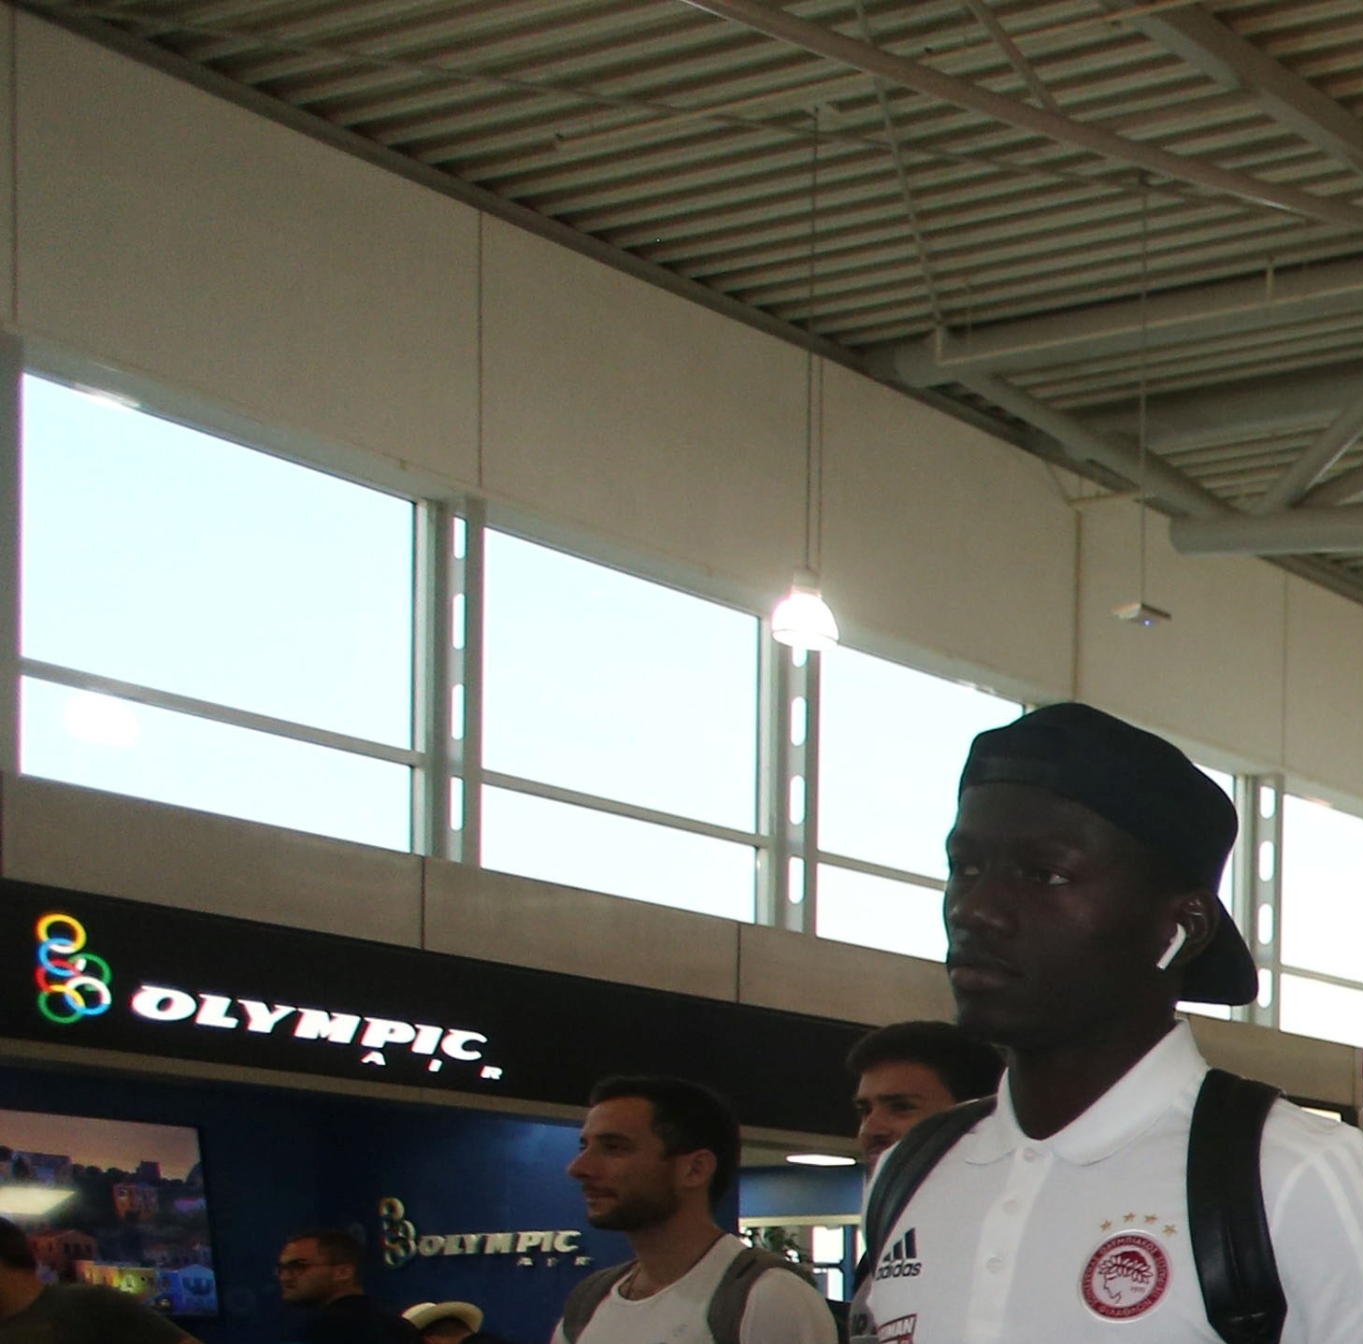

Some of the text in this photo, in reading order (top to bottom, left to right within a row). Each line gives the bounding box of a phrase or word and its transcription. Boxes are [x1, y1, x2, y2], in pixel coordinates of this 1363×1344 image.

[132, 985, 489, 1061] OLYMPIC
[418, 1230, 582, 1257] OLYMPIC
[876, 1259, 922, 1281] adidas
